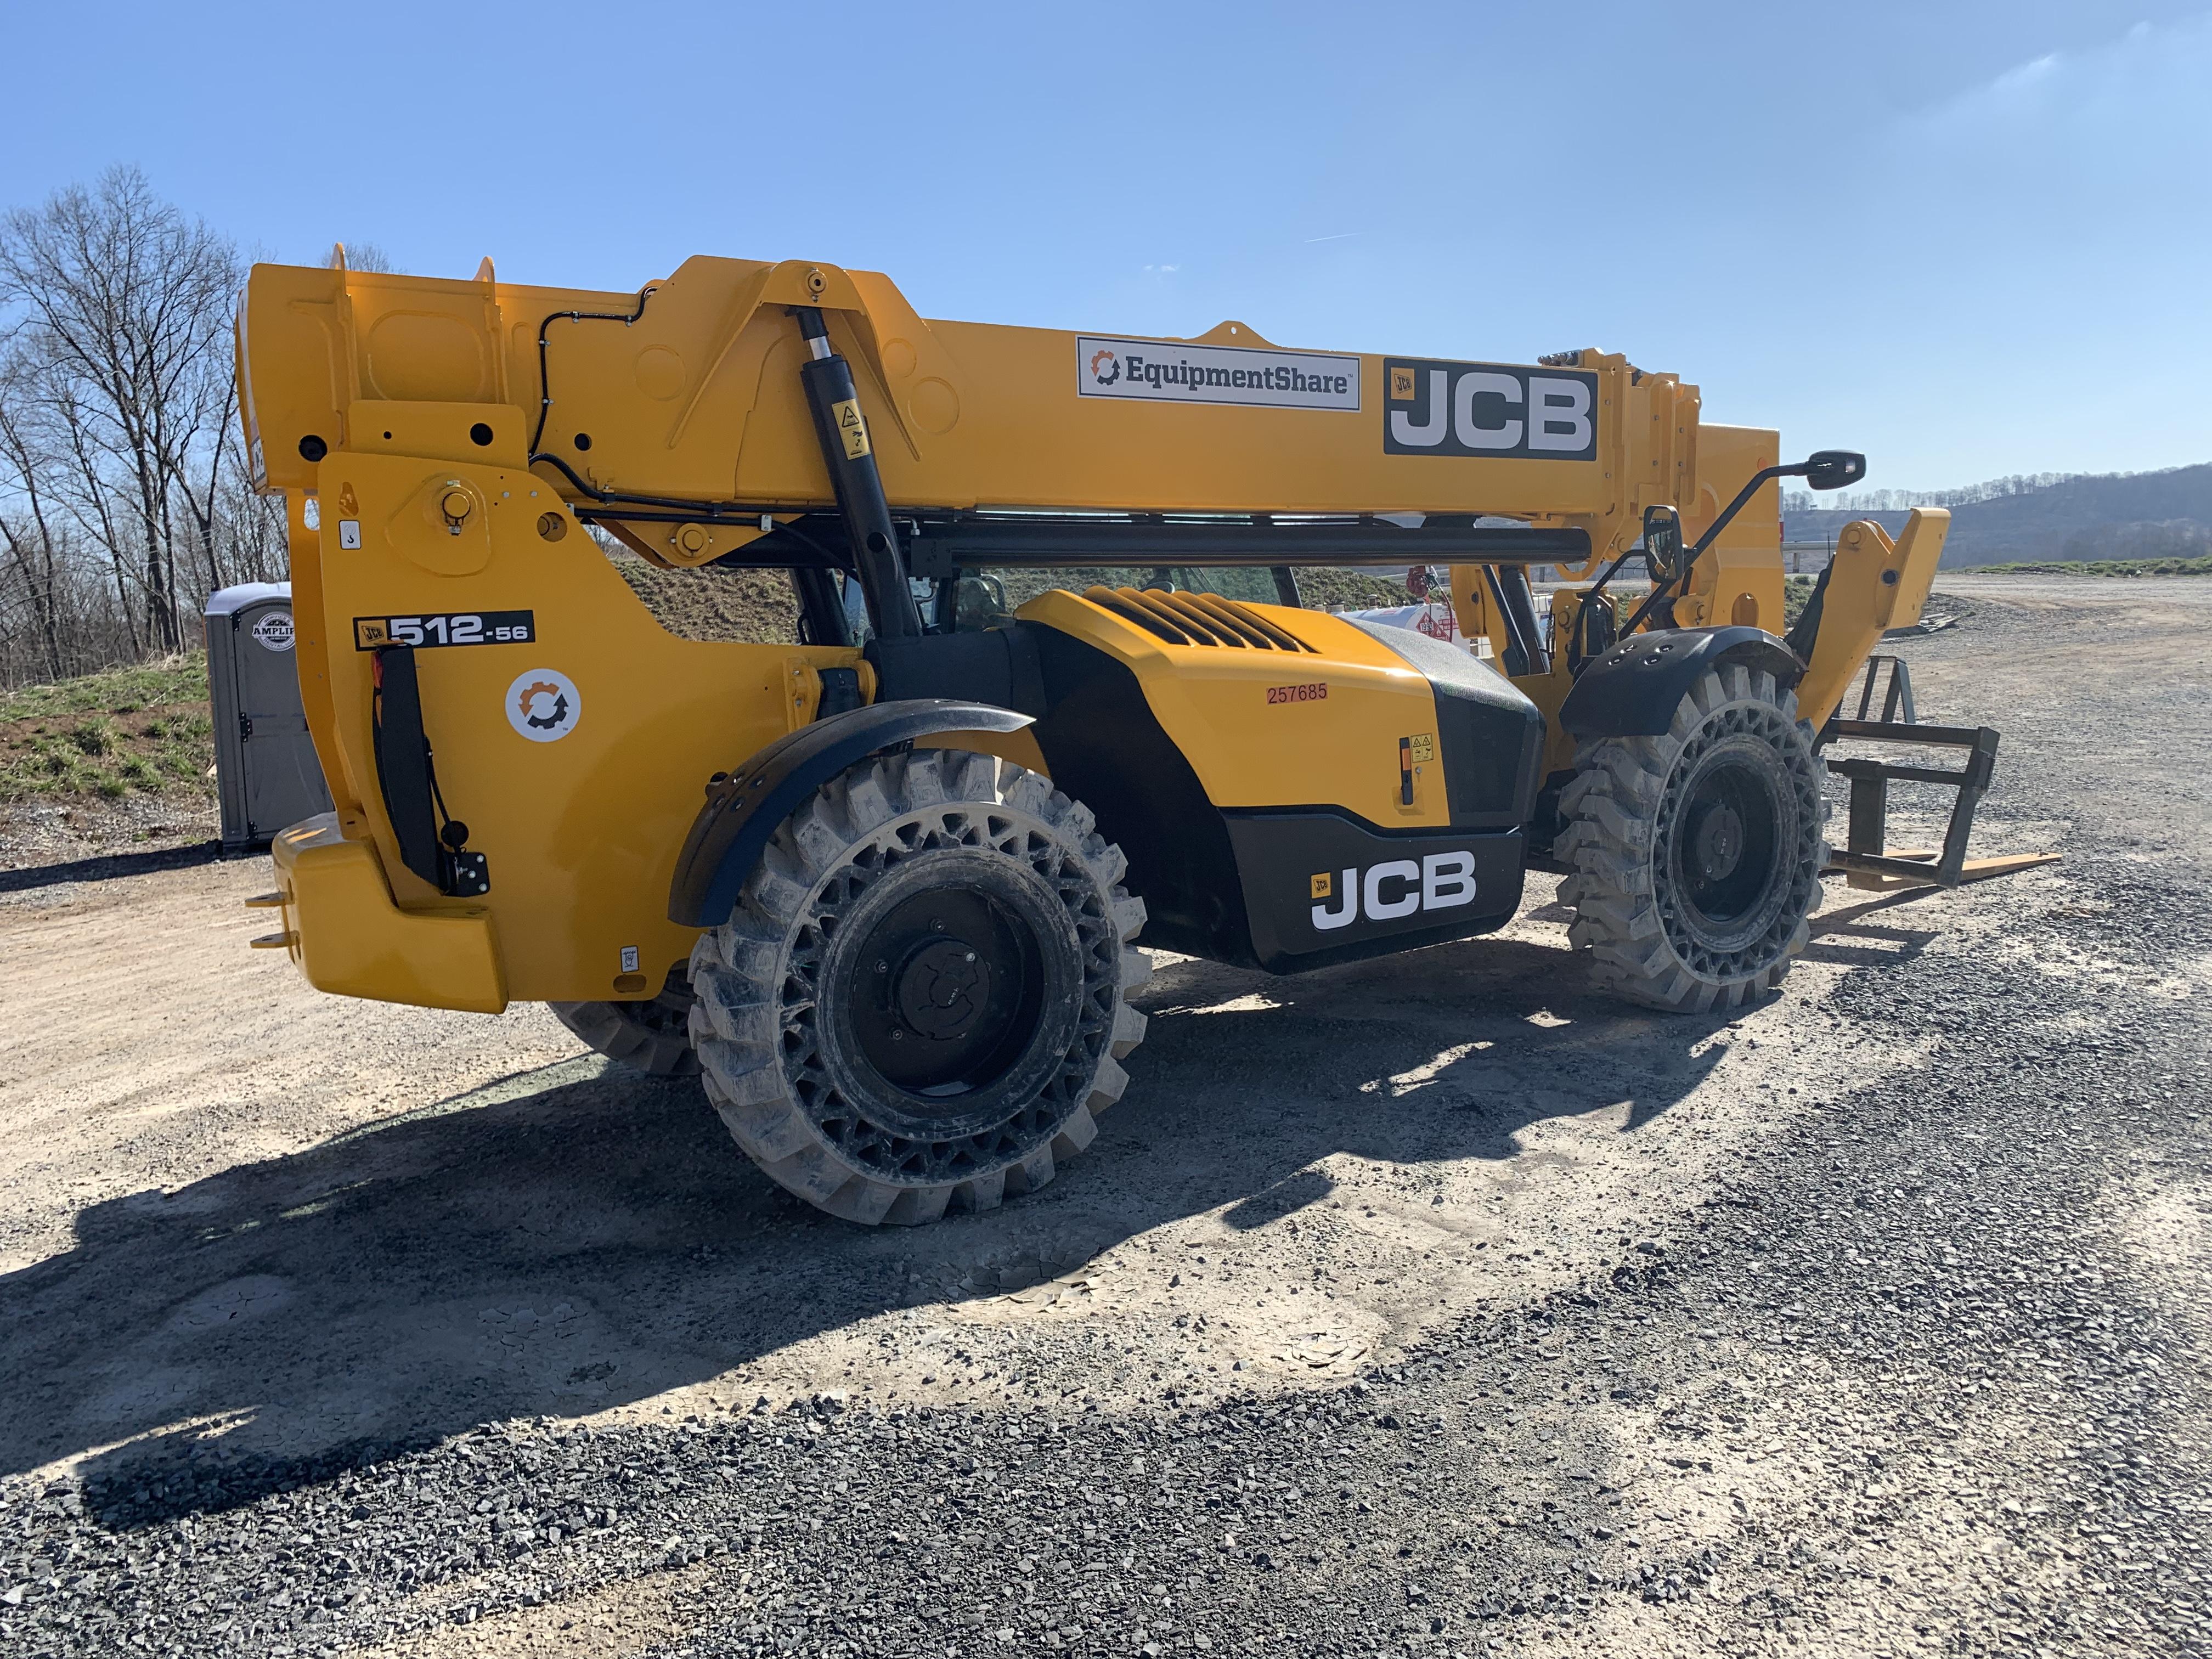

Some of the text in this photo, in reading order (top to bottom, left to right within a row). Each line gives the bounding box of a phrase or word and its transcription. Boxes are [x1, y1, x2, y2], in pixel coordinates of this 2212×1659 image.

[1125, 356, 1347, 394] EquipmentShare
[1396, 376, 1412, 391] JCB
[1391, 370, 1592, 452] JCB
[365, 627, 385, 640] JCB
[390, 615, 528, 646] 512-56
[1267, 683, 1327, 704] 257685
[1312, 850, 1477, 930] JCB
[1316, 879, 1329, 892] JCB
